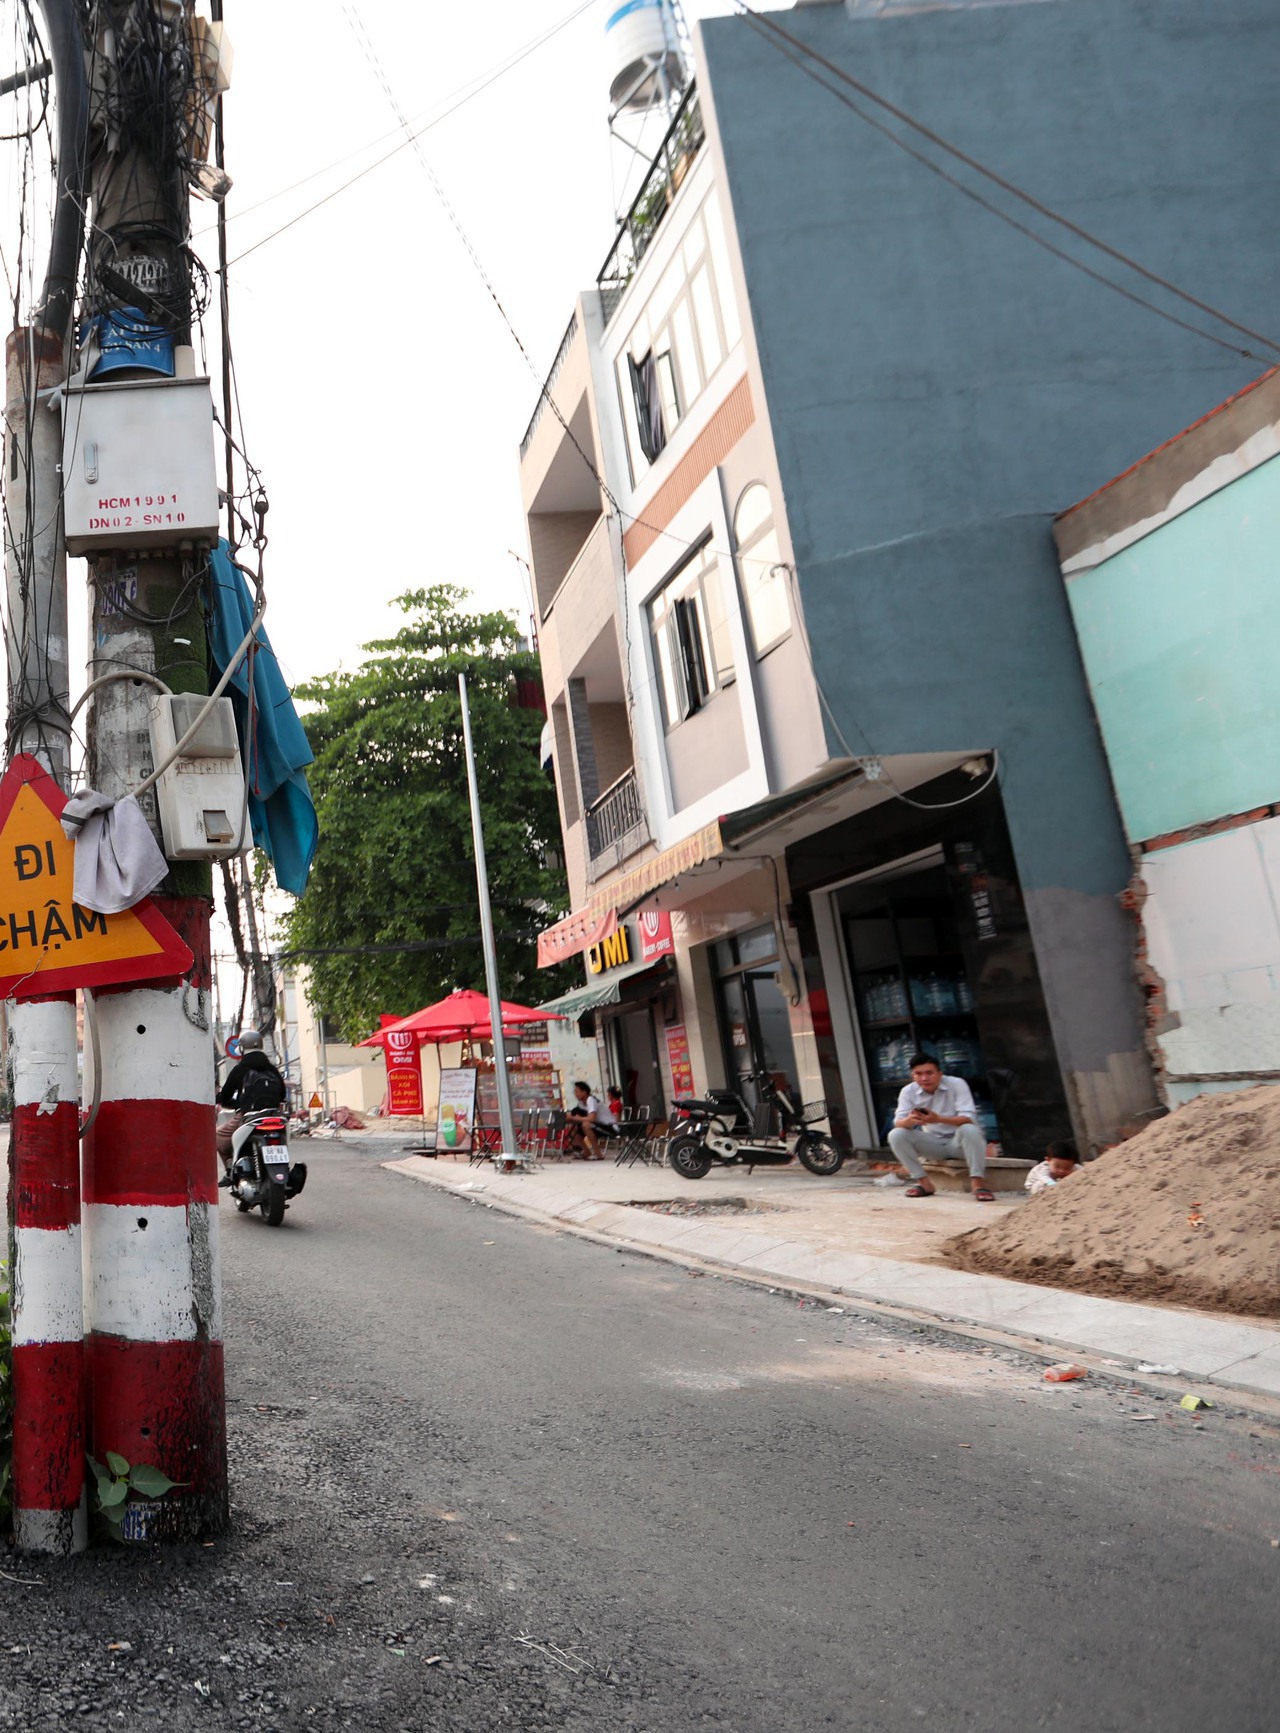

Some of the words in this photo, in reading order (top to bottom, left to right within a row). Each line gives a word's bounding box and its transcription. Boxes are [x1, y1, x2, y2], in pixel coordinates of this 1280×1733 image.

[154, 344, 161, 352] 4
[14, 840, 56, 881] ĐI
[588, 925, 629, 975] OMI
